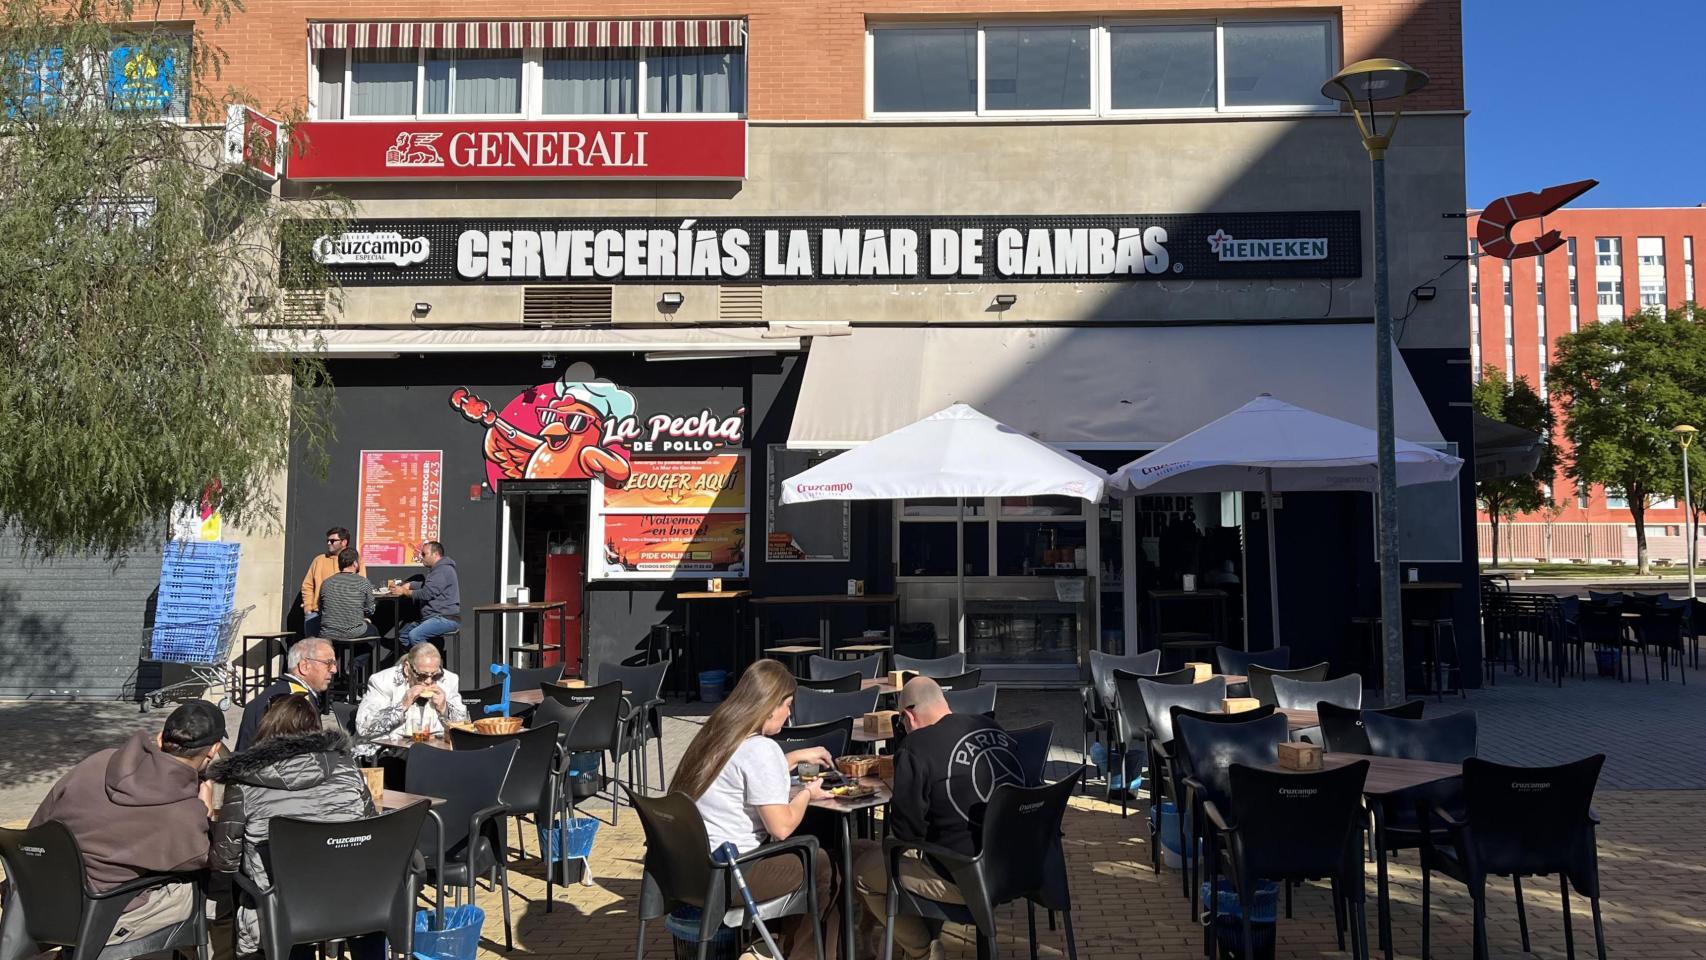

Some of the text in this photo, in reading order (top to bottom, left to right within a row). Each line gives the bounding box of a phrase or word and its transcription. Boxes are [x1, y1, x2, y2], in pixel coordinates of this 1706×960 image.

[449, 131, 649, 167] GENERALI
[320, 238, 423, 257] Cruzcampo
[456, 219, 1170, 278] CERVECERÍAS LA MAR DE GAMBAS
[1222, 241, 1325, 258] HEINEKEN
[602, 407, 746, 447] La Pechá
[633, 441, 713, 452] DE POLLO
[421, 460, 431, 540] PEDIDOS RECOGER:
[428, 461, 440, 539] 854 71 52 43
[797, 482, 853, 493] Cruzcampo
[652, 525, 708, 536] en breve!
[955, 732, 1009, 766] PARIS
[326, 833, 372, 846] Cruzcampo
